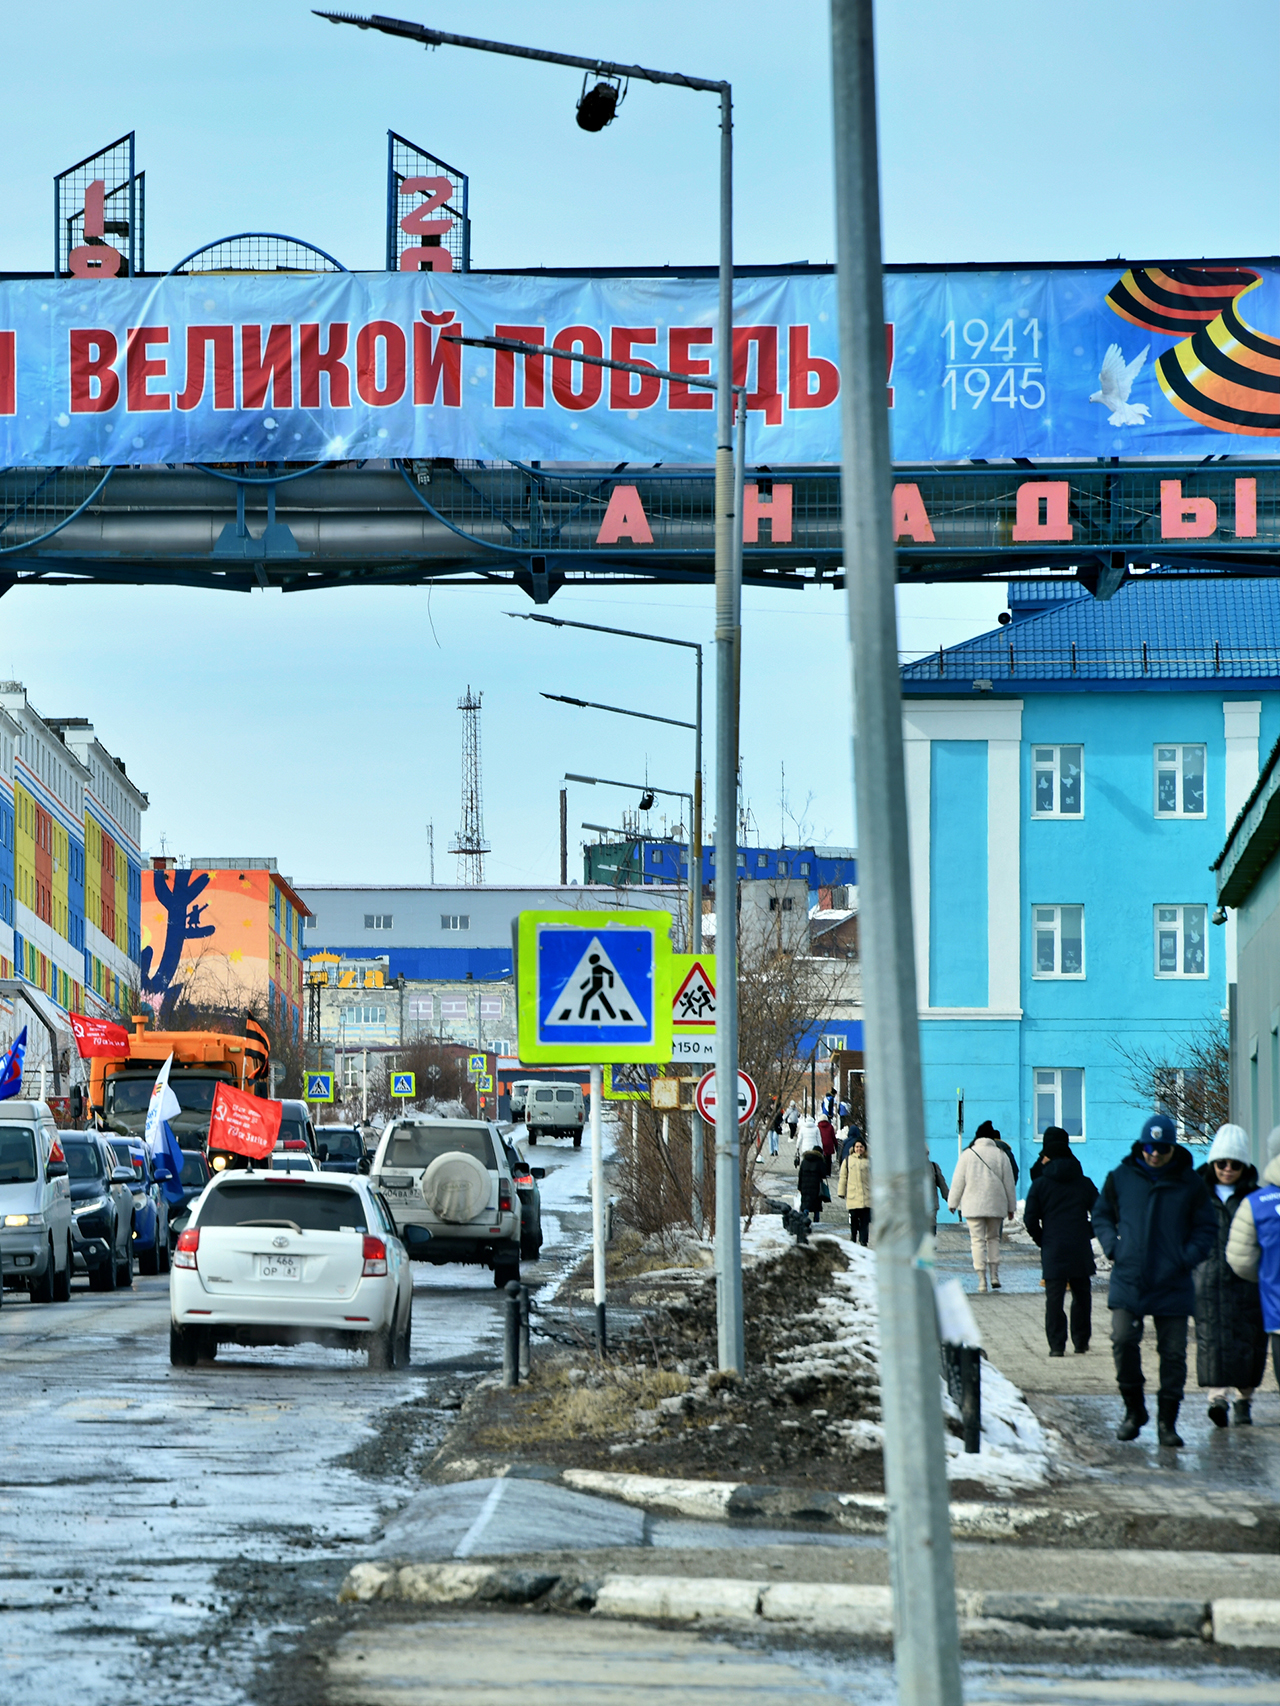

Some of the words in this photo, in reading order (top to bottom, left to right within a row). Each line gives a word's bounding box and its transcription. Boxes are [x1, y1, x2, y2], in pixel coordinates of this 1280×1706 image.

[941, 317, 1041, 360] 1941
[68, 309, 463, 414] ВЕЛИКОЙ
[941, 367, 1046, 411] 1945
[677, 1042, 700, 1053] 150
